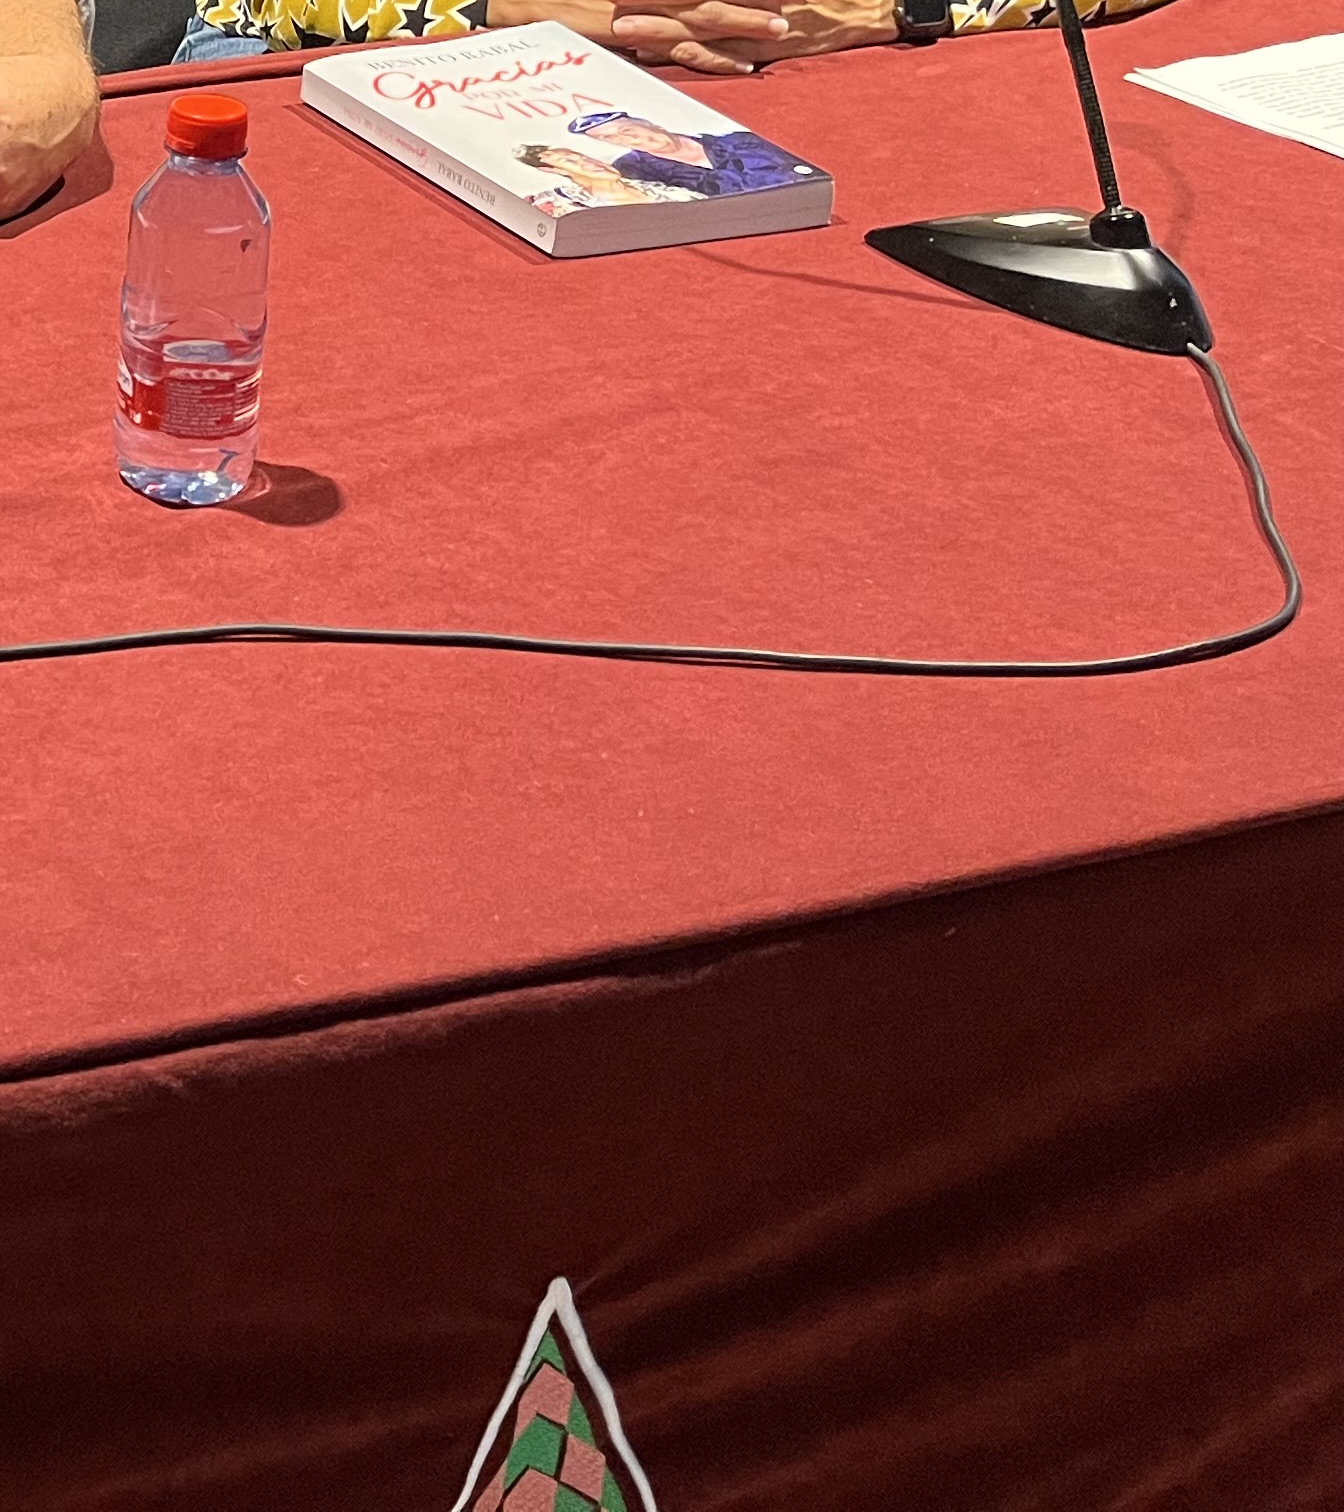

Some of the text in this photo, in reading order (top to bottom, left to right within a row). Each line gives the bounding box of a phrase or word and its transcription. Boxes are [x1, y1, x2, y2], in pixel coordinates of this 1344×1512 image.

[368, 40, 541, 71] BENITO RABAL
[373, 51, 593, 110] Gracias
[463, 82, 564, 102] POR MI
[462, 93, 616, 120] VIDA
